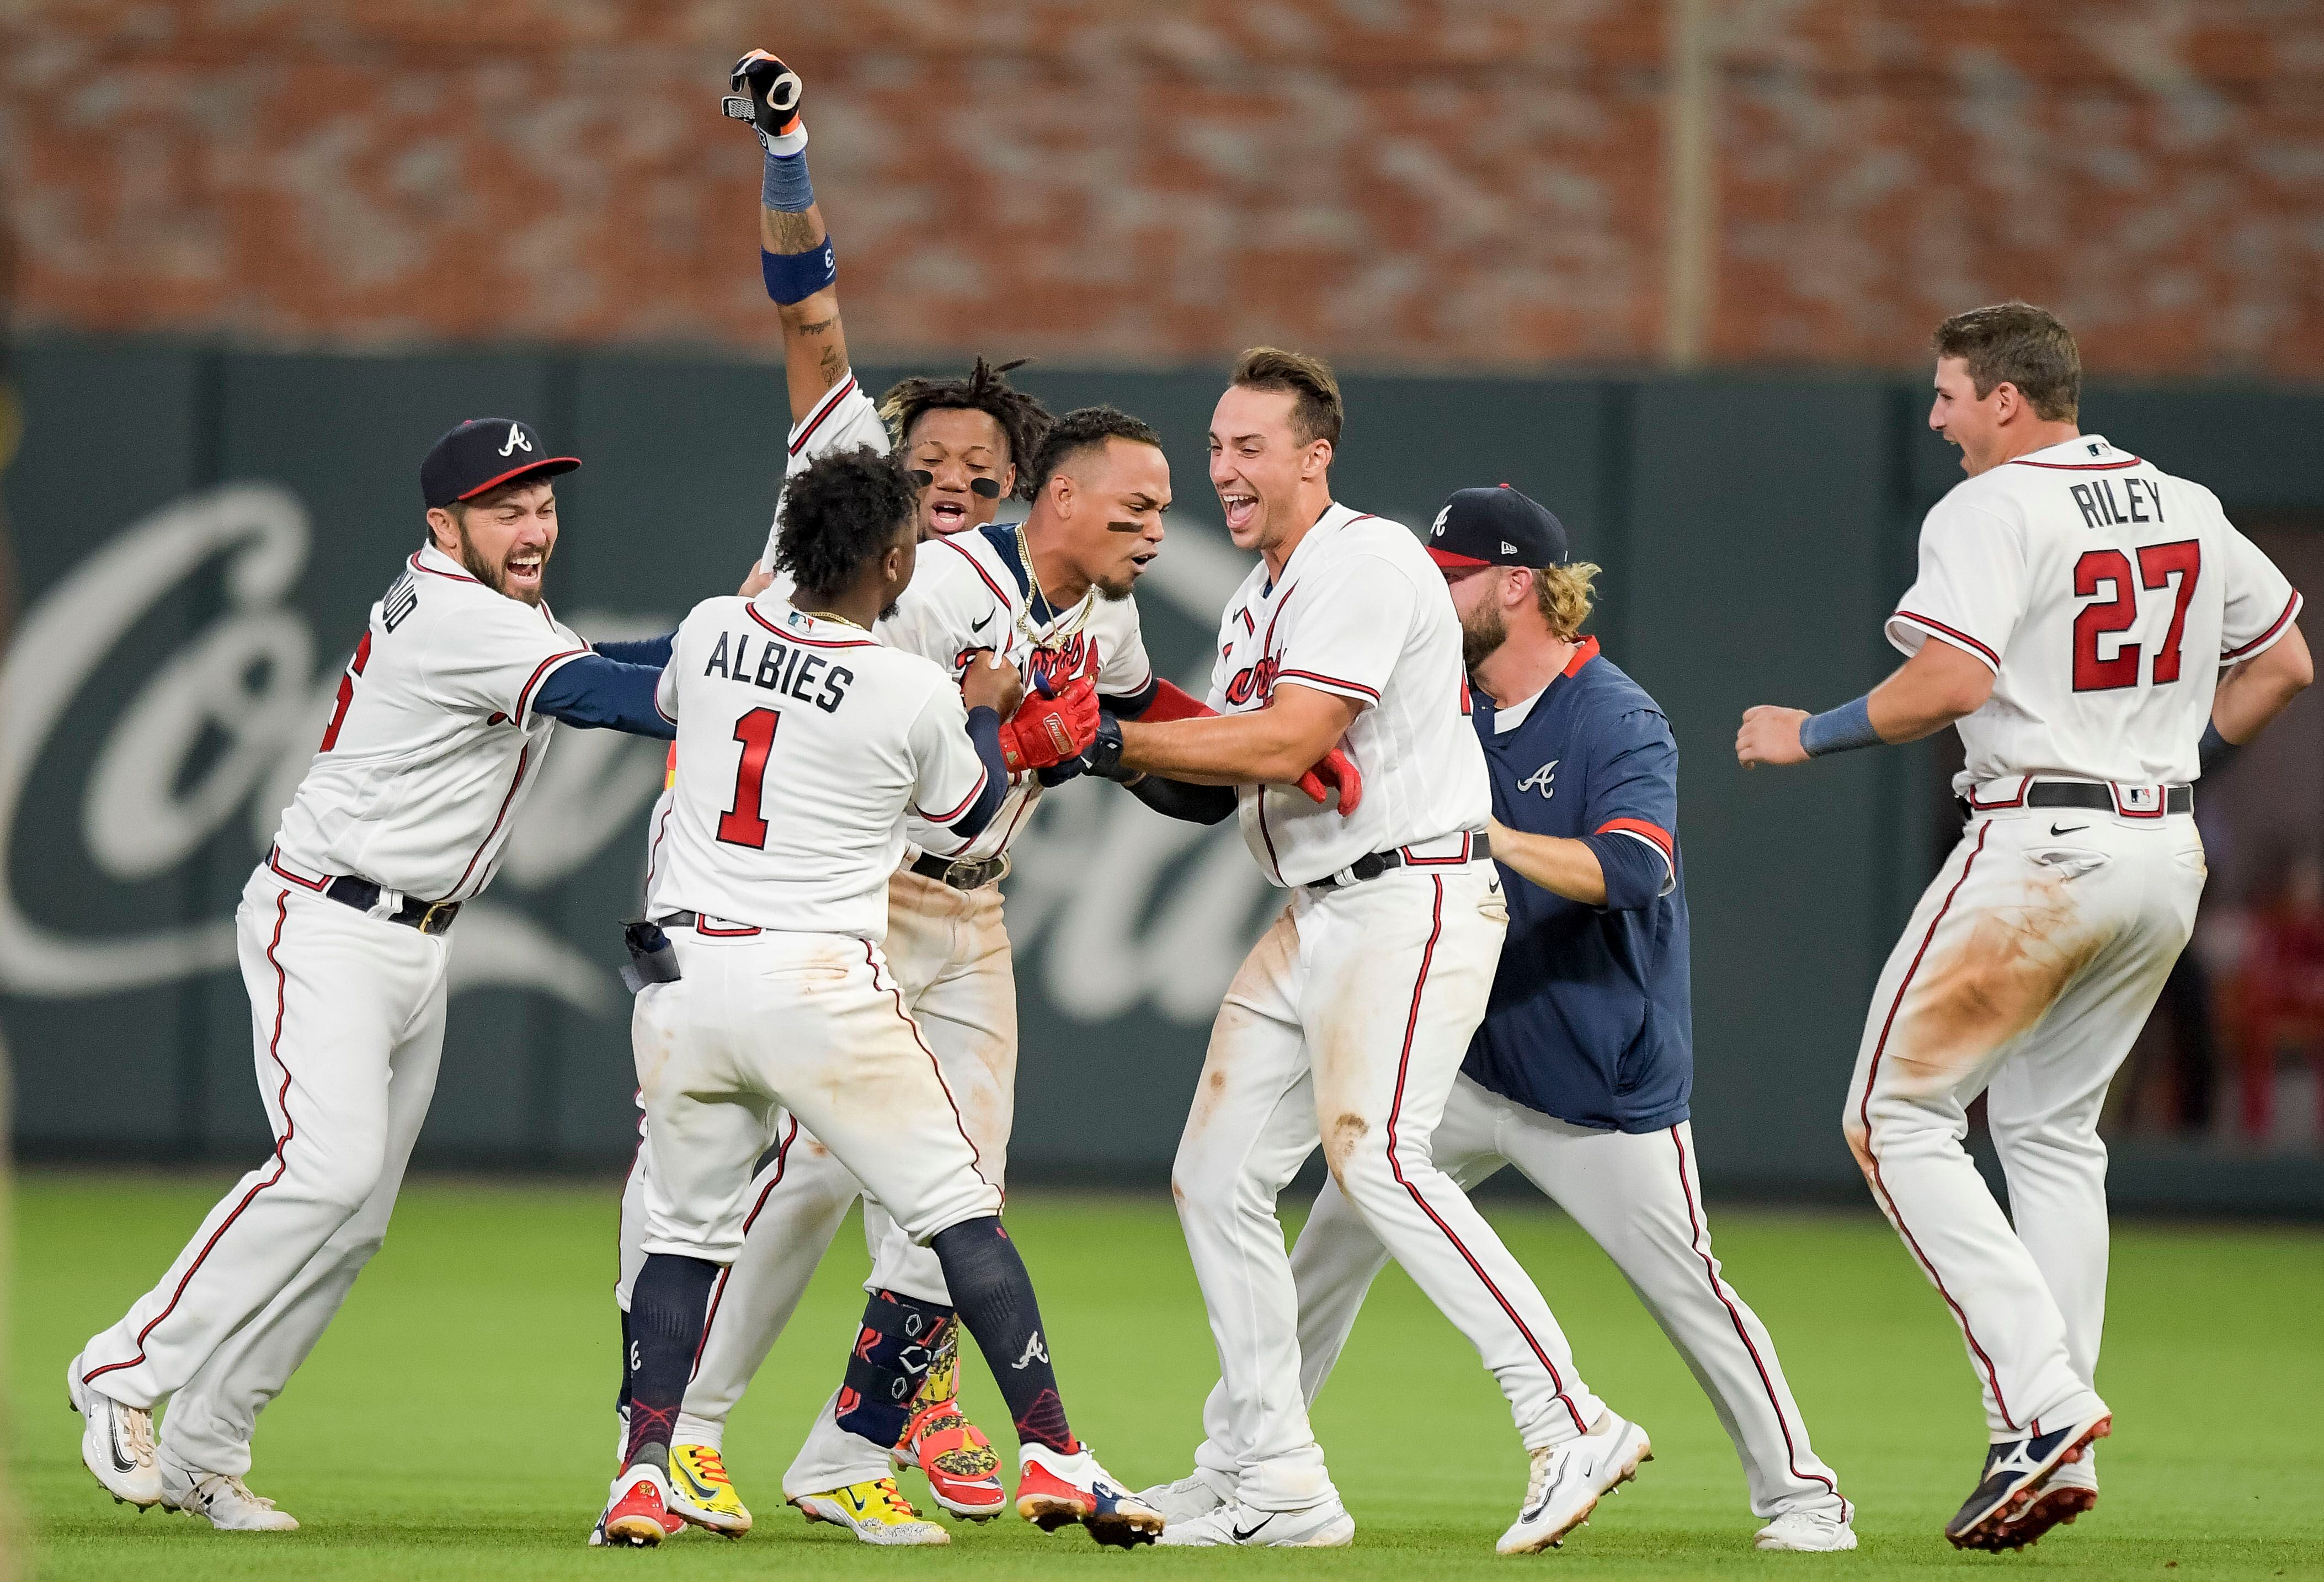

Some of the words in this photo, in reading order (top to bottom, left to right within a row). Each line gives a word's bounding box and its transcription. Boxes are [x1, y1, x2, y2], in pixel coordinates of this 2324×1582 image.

[498, 423, 532, 457] A
[2070, 478, 2165, 529] RILEY
[2072, 538, 2201, 694] 27
[704, 631, 854, 713] ALBIES
[715, 706, 781, 851] 1
[1517, 759, 1560, 799] A
